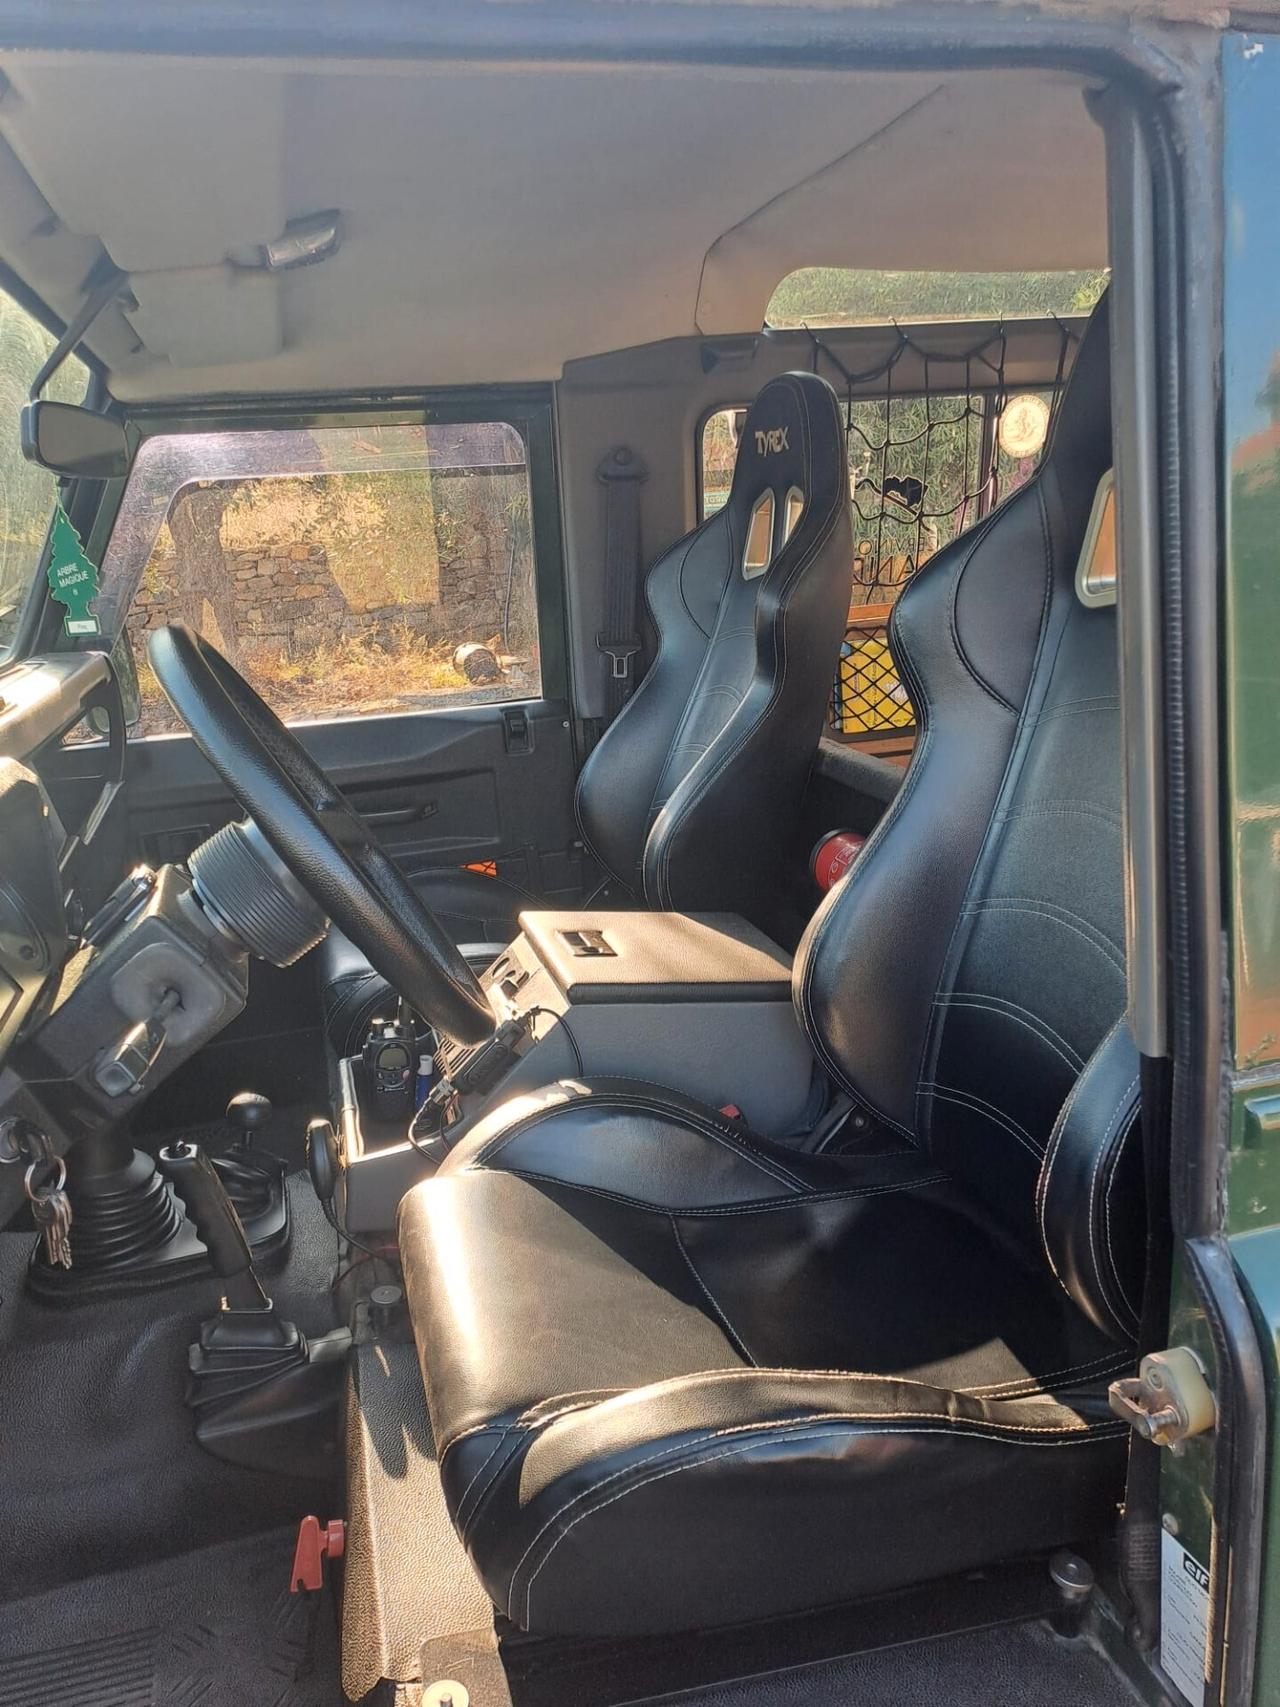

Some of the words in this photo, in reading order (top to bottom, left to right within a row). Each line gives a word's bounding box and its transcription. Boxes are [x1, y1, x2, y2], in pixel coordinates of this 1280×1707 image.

[755, 426, 790, 457] TYREX
[57, 562, 79, 577] ARBRE
[58, 570, 89, 588] MAGIQUE
